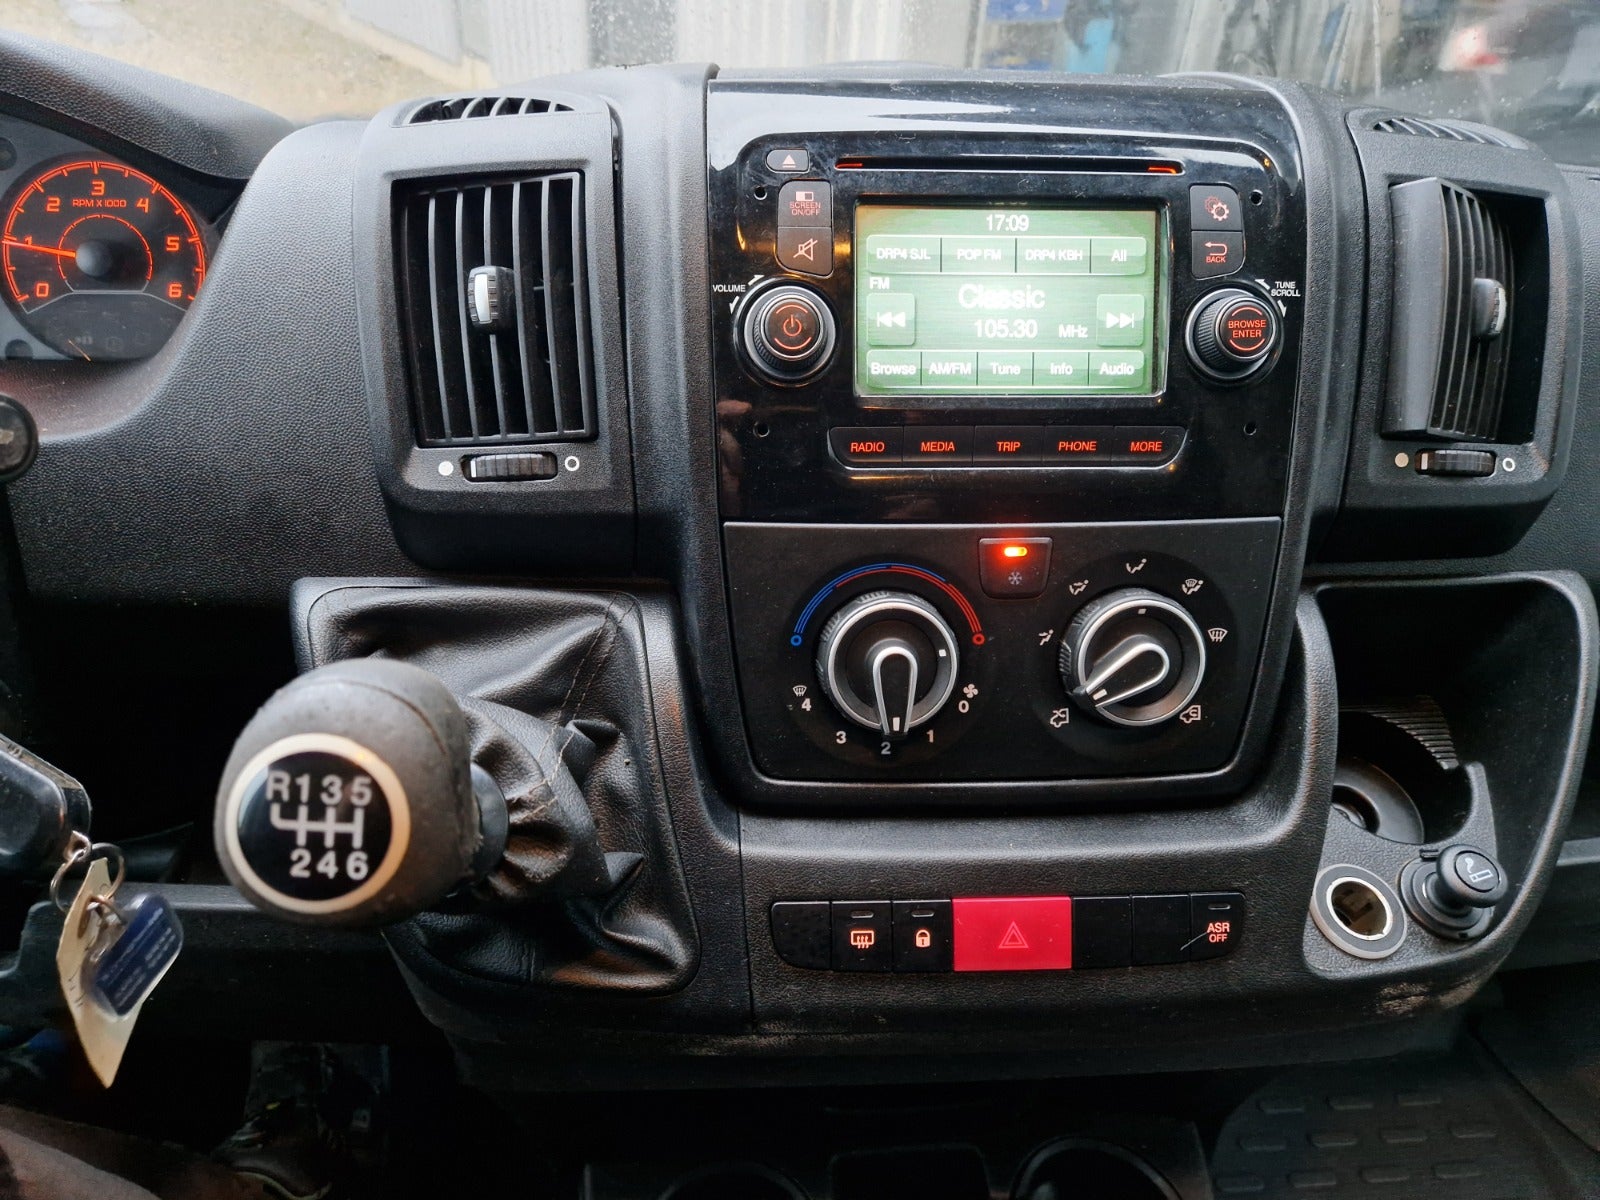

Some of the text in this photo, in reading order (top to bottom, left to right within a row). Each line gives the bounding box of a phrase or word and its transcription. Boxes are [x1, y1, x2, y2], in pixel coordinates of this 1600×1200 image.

[91, 180, 105, 196] 3
[47, 197, 60, 212] 2
[72, 199, 127, 208] RPM X 1000
[136, 198, 149, 213] 4
[986, 214, 1030, 232] 17:09
[166, 236, 180, 251] 5
[876, 248, 931, 260] DRP4 SJL
[957, 249, 1002, 260] POP FM
[1025, 250, 1083, 261] DRP4 KBH
[1111, 249, 1127, 262] All
[712, 284, 746, 293] VOLUME
[869, 277, 890, 290] FM
[1275, 281, 1296, 289] TUNE
[36, 283, 49, 298] 0
[168, 283, 182, 298] 6
[958, 284, 1046, 309] Classic
[1271, 289, 1300, 297] SCROLL
[974, 319, 1088, 339] 105.30 MHz
[1228, 319, 1266, 329] BROWSE
[1232, 328, 1262, 338] ENTER
[870, 362, 916, 375] Browse
[991, 362, 1021, 375] Tune
[1050, 361, 1073, 375] Info
[1099, 361, 1135, 375] Audio
[850, 442, 885, 452] RADIO
[920, 442, 955, 452] MEDIA
[996, 442, 1021, 452] TRIP
[1058, 441, 1097, 451] PHONE
[1129, 441, 1163, 452] MORE
[801, 698, 812, 711] 4
[958, 700, 970, 713] 0
[835, 731, 847, 744] 3
[926, 730, 935, 742] 1
[880, 742, 892, 755] 2
[266, 770, 373, 807] R 1 3 5
[289, 848, 369, 880] 2 4 6
[1207, 922, 1230, 933] ASR
[1208, 933, 1228, 943] OFF
